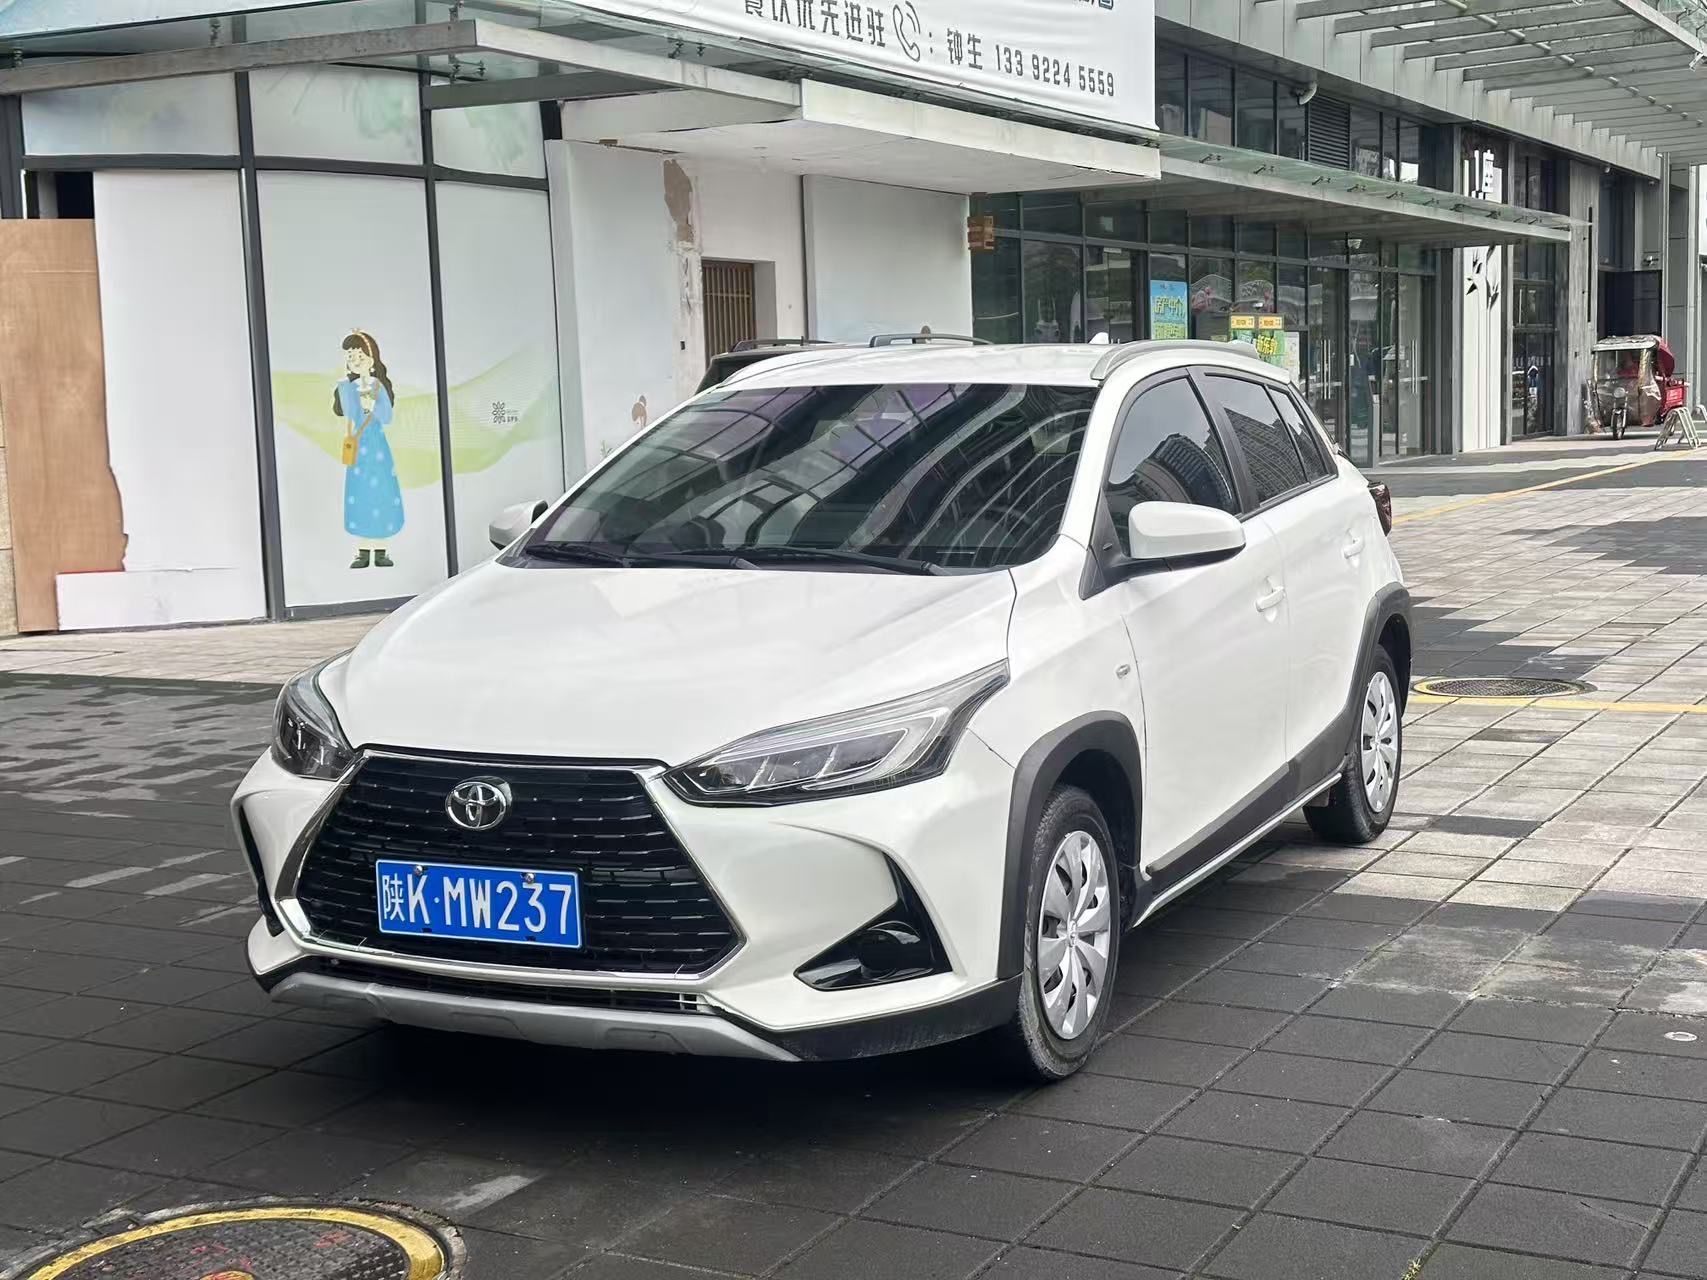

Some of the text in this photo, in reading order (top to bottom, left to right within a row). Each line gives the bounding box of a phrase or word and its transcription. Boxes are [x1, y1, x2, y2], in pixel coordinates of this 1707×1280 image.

[995, 45, 1023, 76] 133
[1032, 54, 1070, 87] 9224
[1078, 65, 1114, 96] 5559
[381, 873, 573, 935] 陕K·MW237
